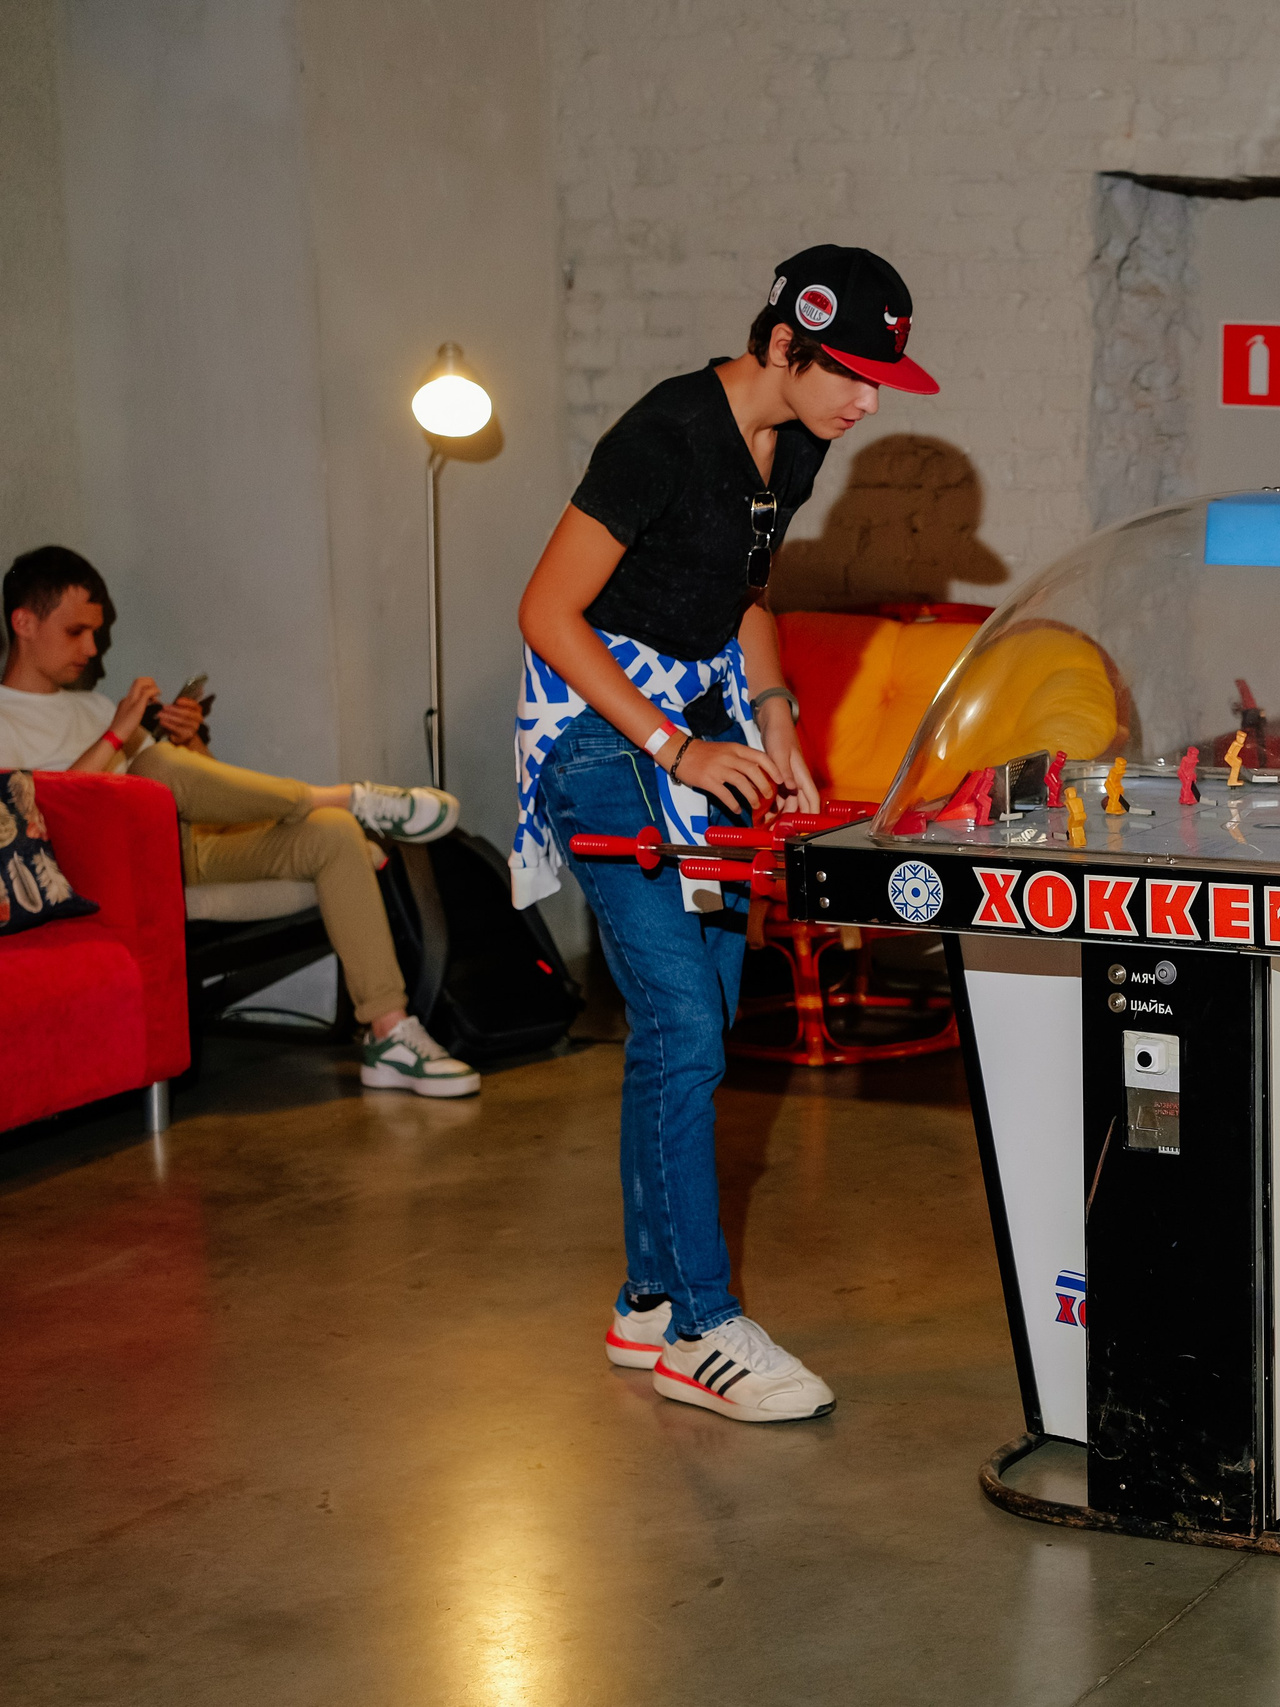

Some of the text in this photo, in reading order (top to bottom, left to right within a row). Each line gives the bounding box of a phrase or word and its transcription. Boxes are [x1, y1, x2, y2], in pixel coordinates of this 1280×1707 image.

[802, 302, 824, 321] BULLS
[1130, 971, 1156, 985] МЯЧ
[1130, 999, 1174, 1016] ШАЙБА
